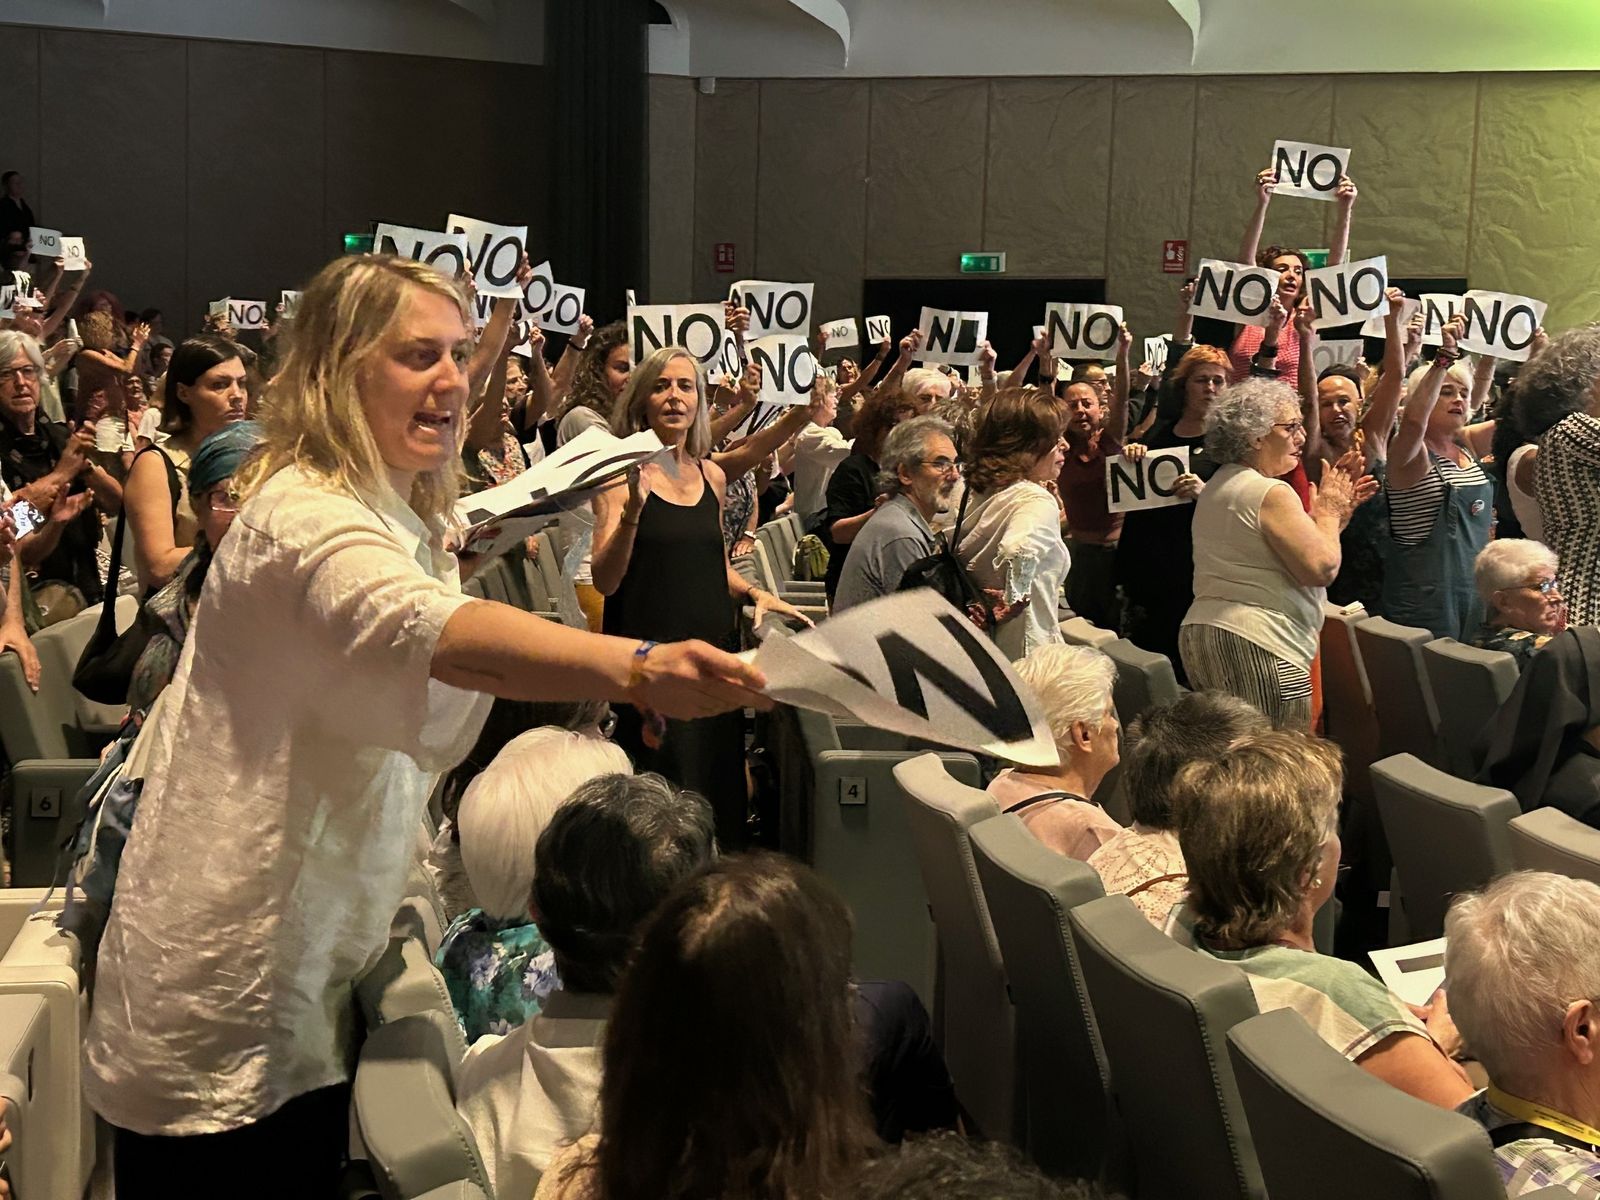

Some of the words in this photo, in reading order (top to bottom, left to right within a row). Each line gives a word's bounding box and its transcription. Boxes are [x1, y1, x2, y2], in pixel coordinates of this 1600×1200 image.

[1274, 147, 1342, 191] NO
[40, 235, 55, 246] NO
[745, 290, 808, 329] NO
[1193, 267, 1271, 316] NO
[1311, 267, 1384, 319] NO
[228, 304, 262, 324] NO
[832, 326, 848, 338] NO
[1050, 310, 1119, 350] NO
[1425, 299, 1454, 335] N
[1464, 298, 1536, 350] NO
[633, 313, 721, 365] NO
[751, 343, 816, 394] NO
[1110, 455, 1185, 503] NO
[40, 796, 51, 811] 6
[848, 784, 857, 798] 4
